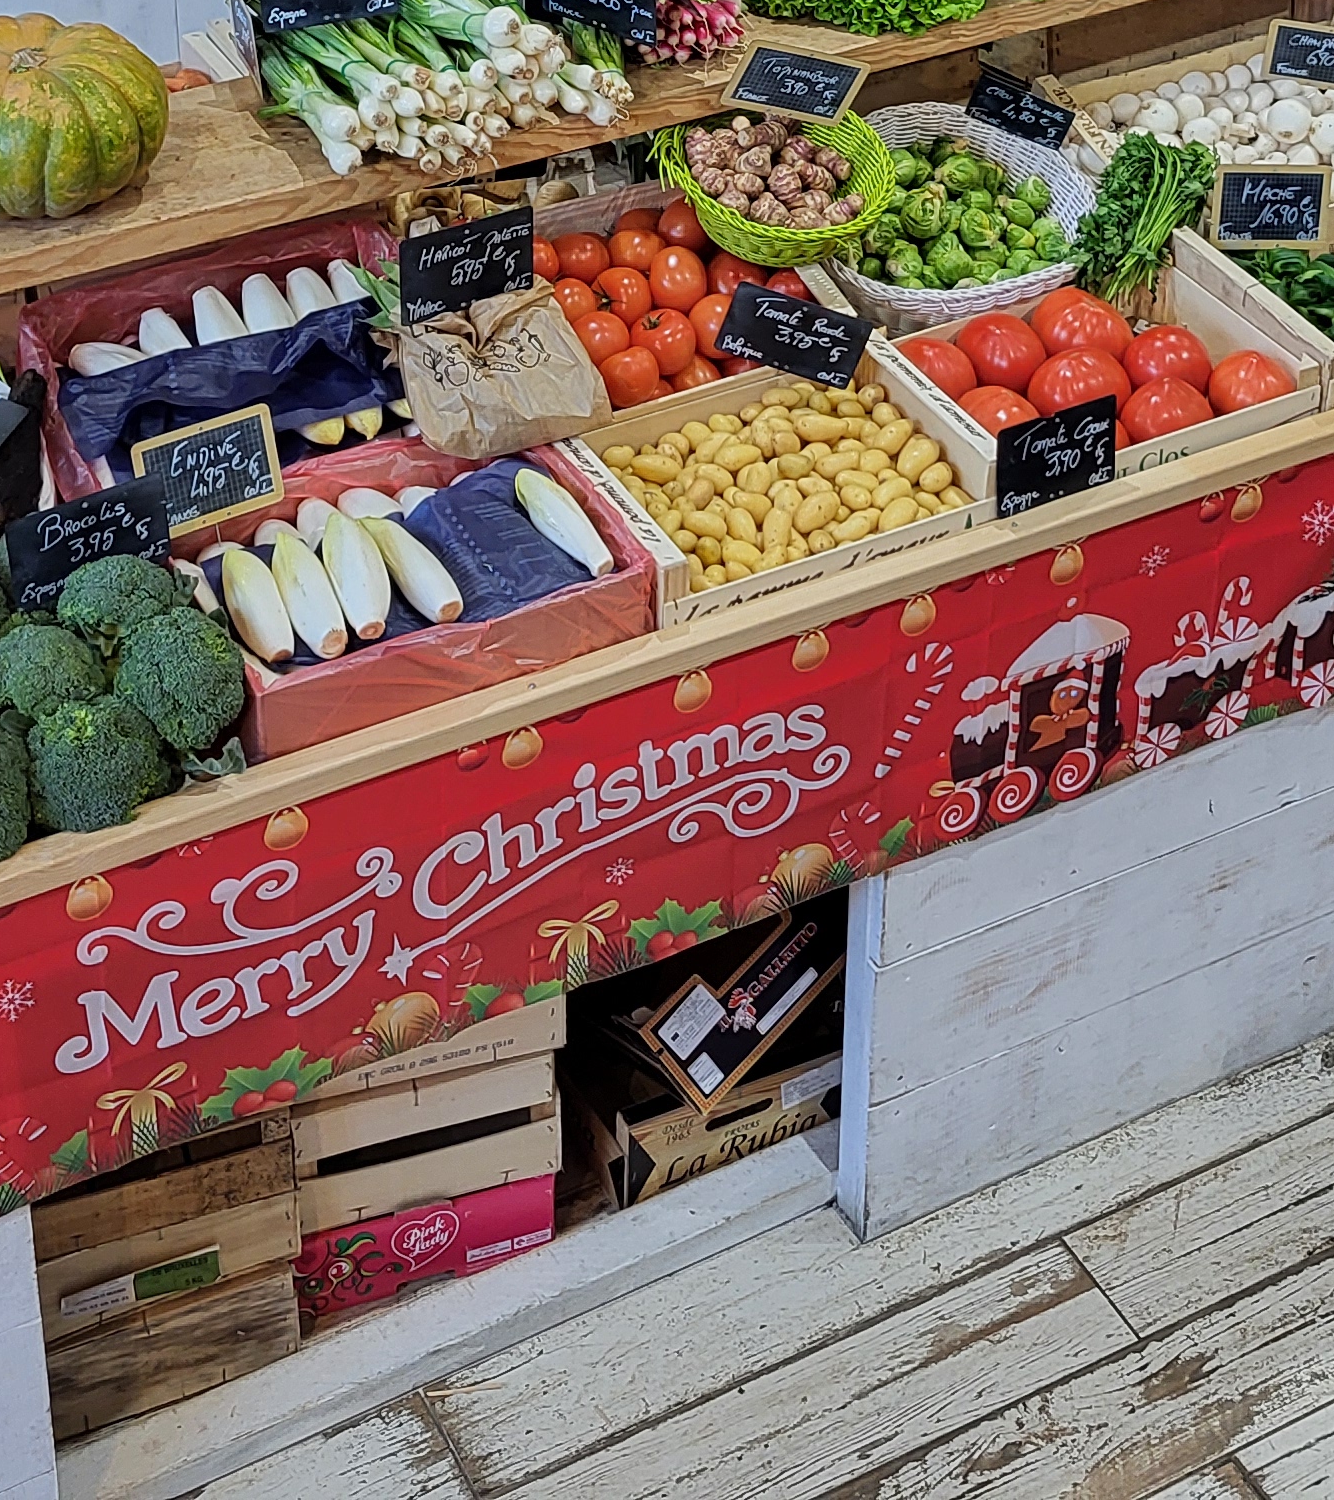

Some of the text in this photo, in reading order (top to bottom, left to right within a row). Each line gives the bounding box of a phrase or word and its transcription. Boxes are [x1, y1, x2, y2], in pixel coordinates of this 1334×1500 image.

[54, 703, 828, 1074] Merry Christmas
[659, 1112, 818, 1188] La Rubia
[403, 1217, 451, 1257] Pink Lady
